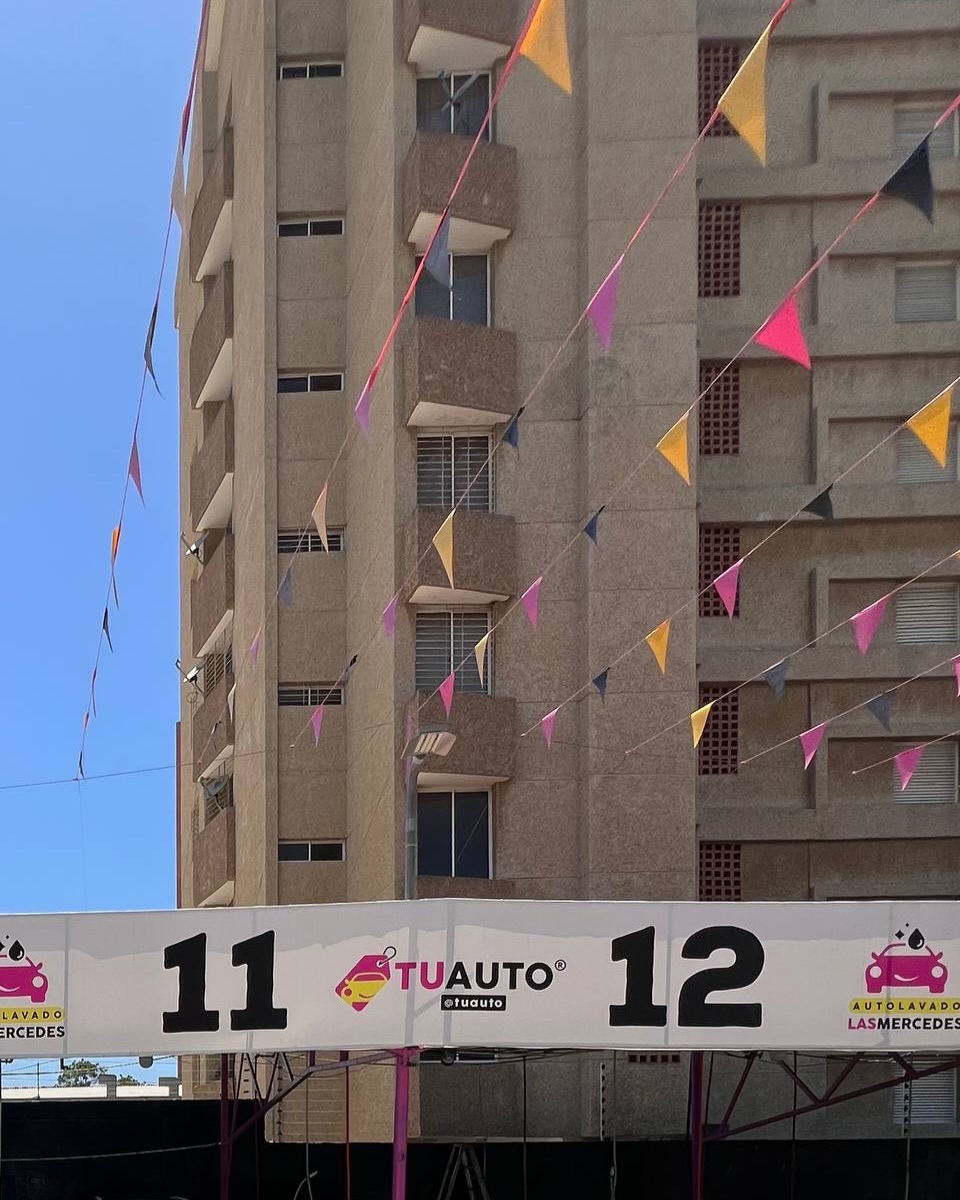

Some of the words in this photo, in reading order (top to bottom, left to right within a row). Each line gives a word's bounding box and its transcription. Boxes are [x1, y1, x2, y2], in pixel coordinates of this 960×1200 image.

[162, 930, 289, 1034] 11
[443, 997, 504, 1009] @tuauto
[609, 926, 766, 1028] 12
